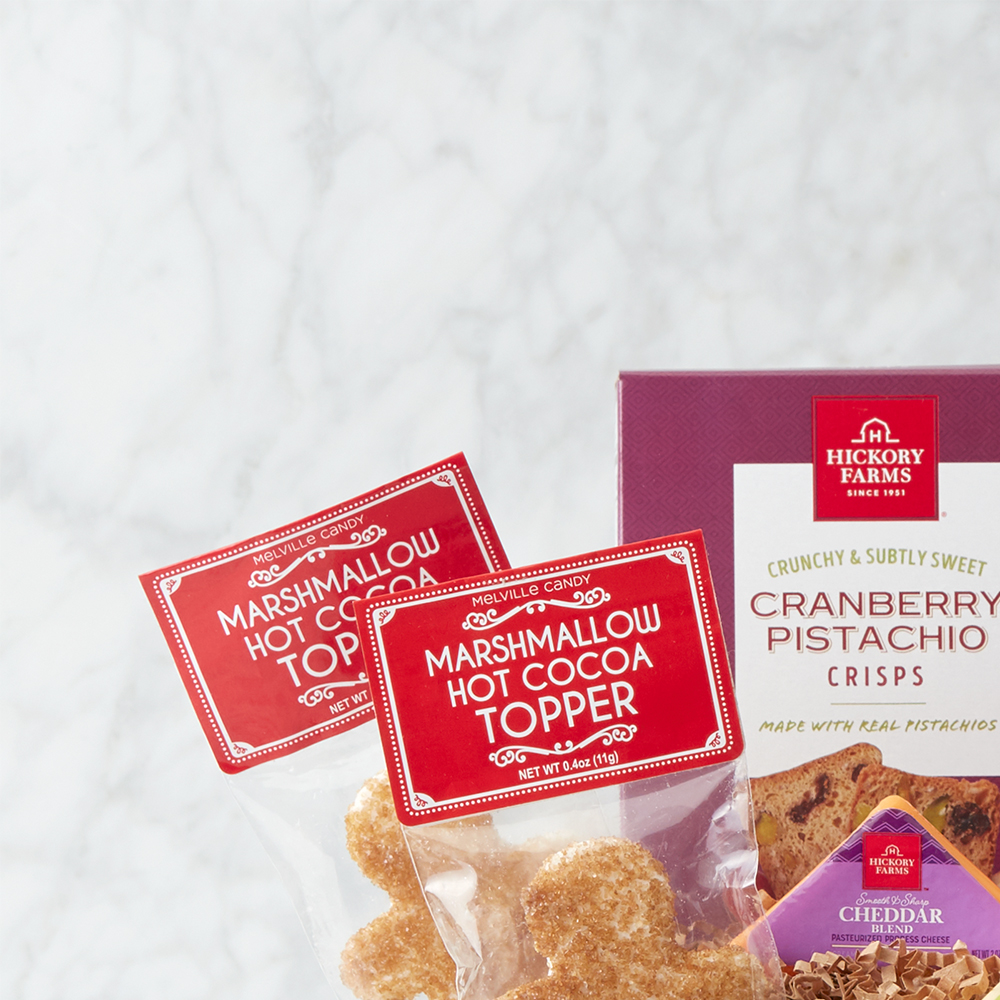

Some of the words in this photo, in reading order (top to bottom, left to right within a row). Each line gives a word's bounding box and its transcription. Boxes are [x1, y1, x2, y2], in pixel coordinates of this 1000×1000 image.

[826, 449, 925, 465] HICKORY
[840, 468, 912, 484] FARMS
[847, 489, 880, 497] SINCE
[883, 489, 906, 497] 1951
[768, 550, 845, 578] CRUNCHY
[850, 549, 861, 564] &
[866, 548, 928, 568] SUBTLY
[931, 552, 988, 577] SWEET
[217, 527, 440, 636] MARSHMALLOW
[244, 617, 307, 661] HOT
[424, 603, 661, 677] MARSHMALLOW
[767, 624, 988, 653] PISTACHIO
[277, 632, 359, 687] TOP
[447, 668, 510, 708] HOT
[522, 642, 653, 692] COCOA
[828, 666, 924, 687] CRISPS
[329, 697, 350, 715] NET
[351, 690, 368, 705] WT
[475, 680, 638, 744] TOPPER
[759, 720, 806, 733] MADE
[811, 720, 854, 733] WITH
[859, 720, 900, 732] REAL
[904, 719, 998, 733] PISTACHIOS
[518, 766, 542, 780] NET
[542, 763, 561, 775] WT
[563, 757, 591, 772] 0.4oz
[593, 750, 619, 769] (11g)
[869, 857, 915, 867] HICKORY
[875, 866, 909, 875] FARMS
[856, 892, 890, 906] Smooth
[900, 893, 929, 909] Sharp
[838, 906, 944, 924] CHEDDAR
[831, 934, 882, 942] PASTEURIZED
[885, 935, 919, 944] PRESS
[921, 936, 950, 944] CHEESE
[871, 924, 914, 934] BLEND
